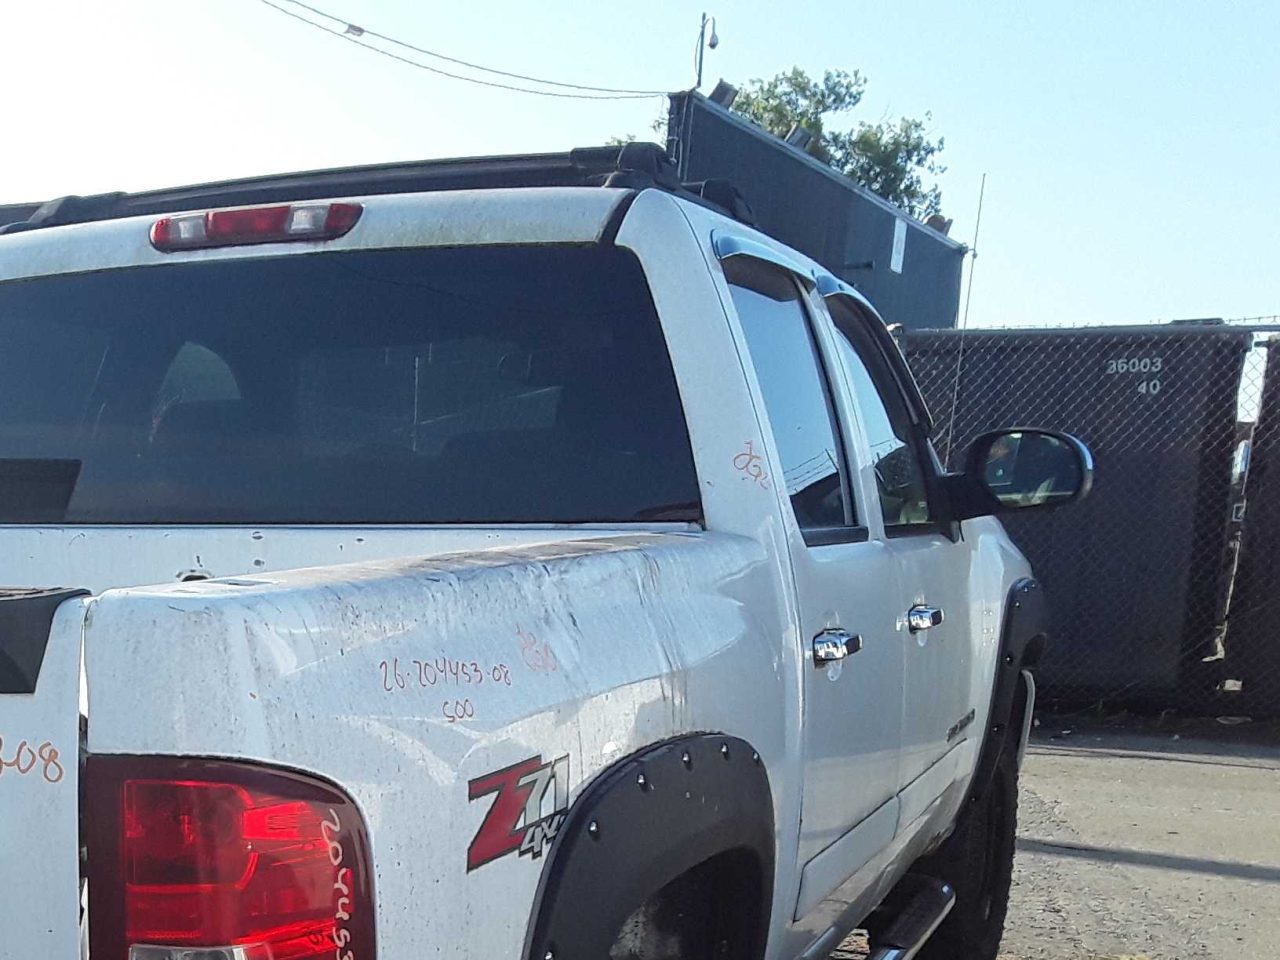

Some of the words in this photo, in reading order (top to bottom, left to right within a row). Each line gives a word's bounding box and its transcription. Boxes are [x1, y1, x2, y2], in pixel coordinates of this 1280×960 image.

[1106, 358, 1162, 374] 36003
[1137, 379, 1161, 395] 40
[466, 753, 570, 874] Z71
